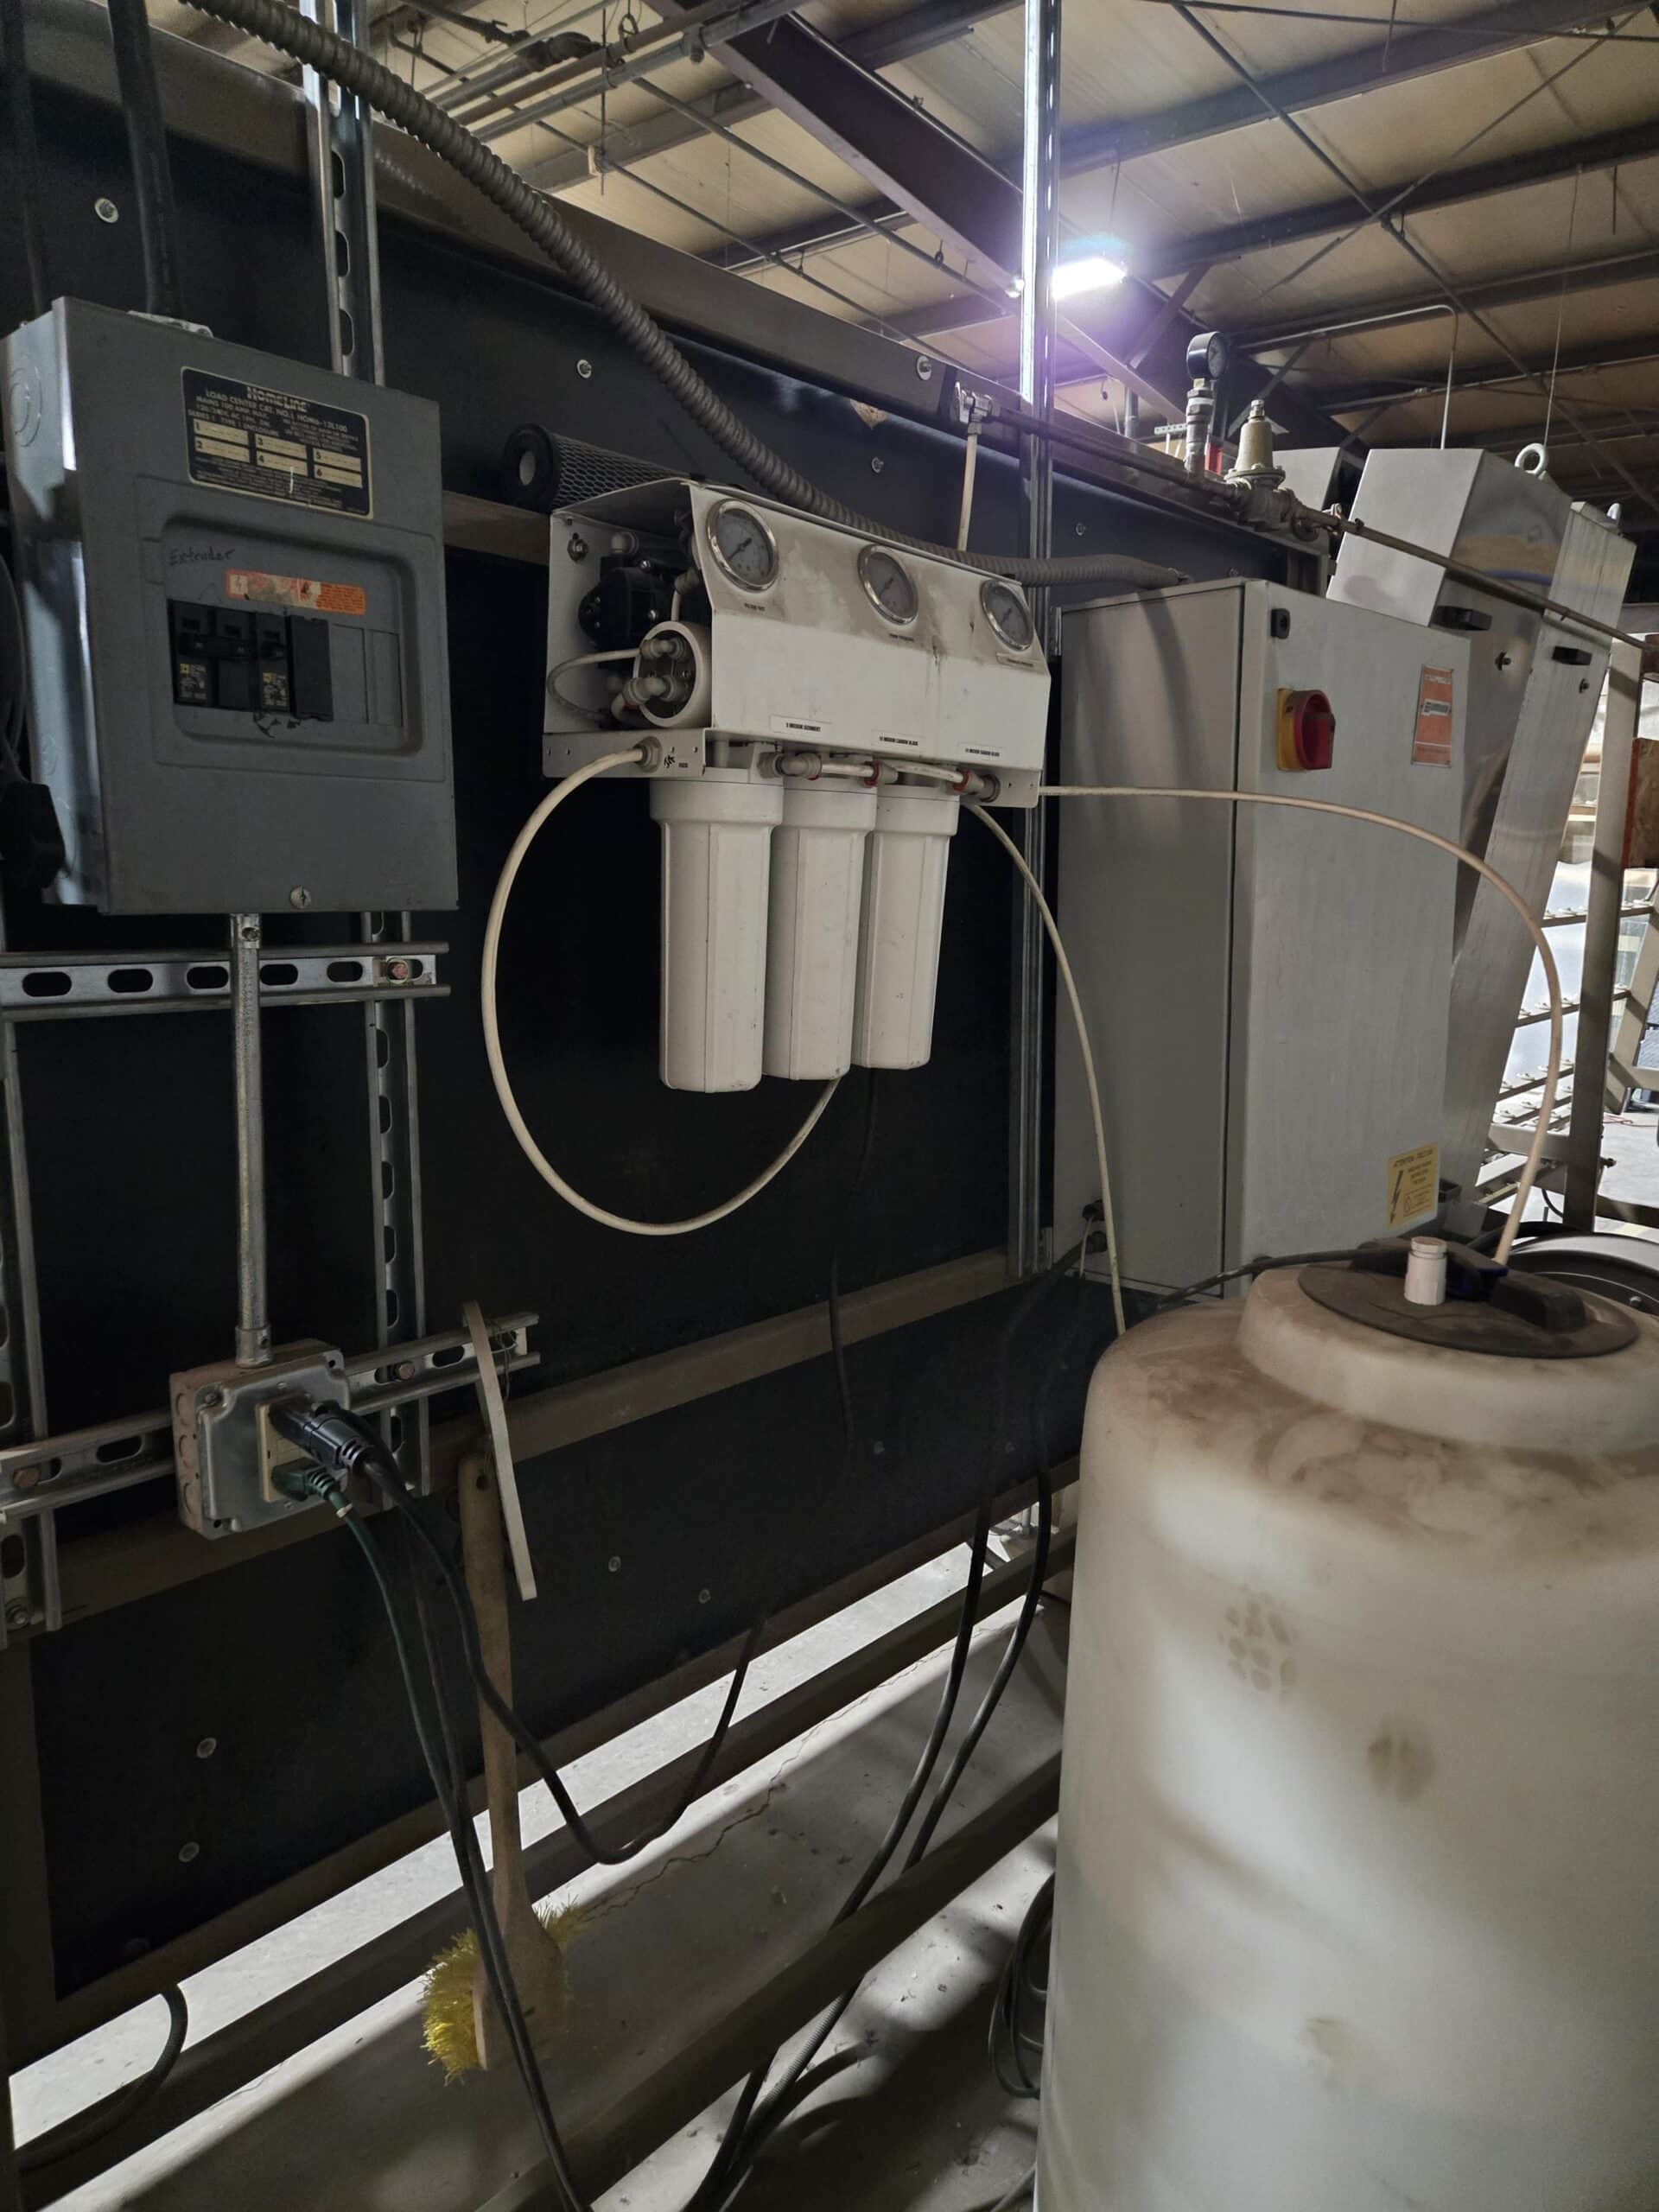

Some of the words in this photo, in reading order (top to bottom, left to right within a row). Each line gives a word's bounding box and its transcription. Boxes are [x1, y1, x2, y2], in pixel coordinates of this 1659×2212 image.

[205, 389, 228, 402] LOAD
[229, 395, 257, 410] CENTER
[257, 454, 264, 463] 4
[315, 451, 321, 460] 5
[315, 467, 321, 476] 6
